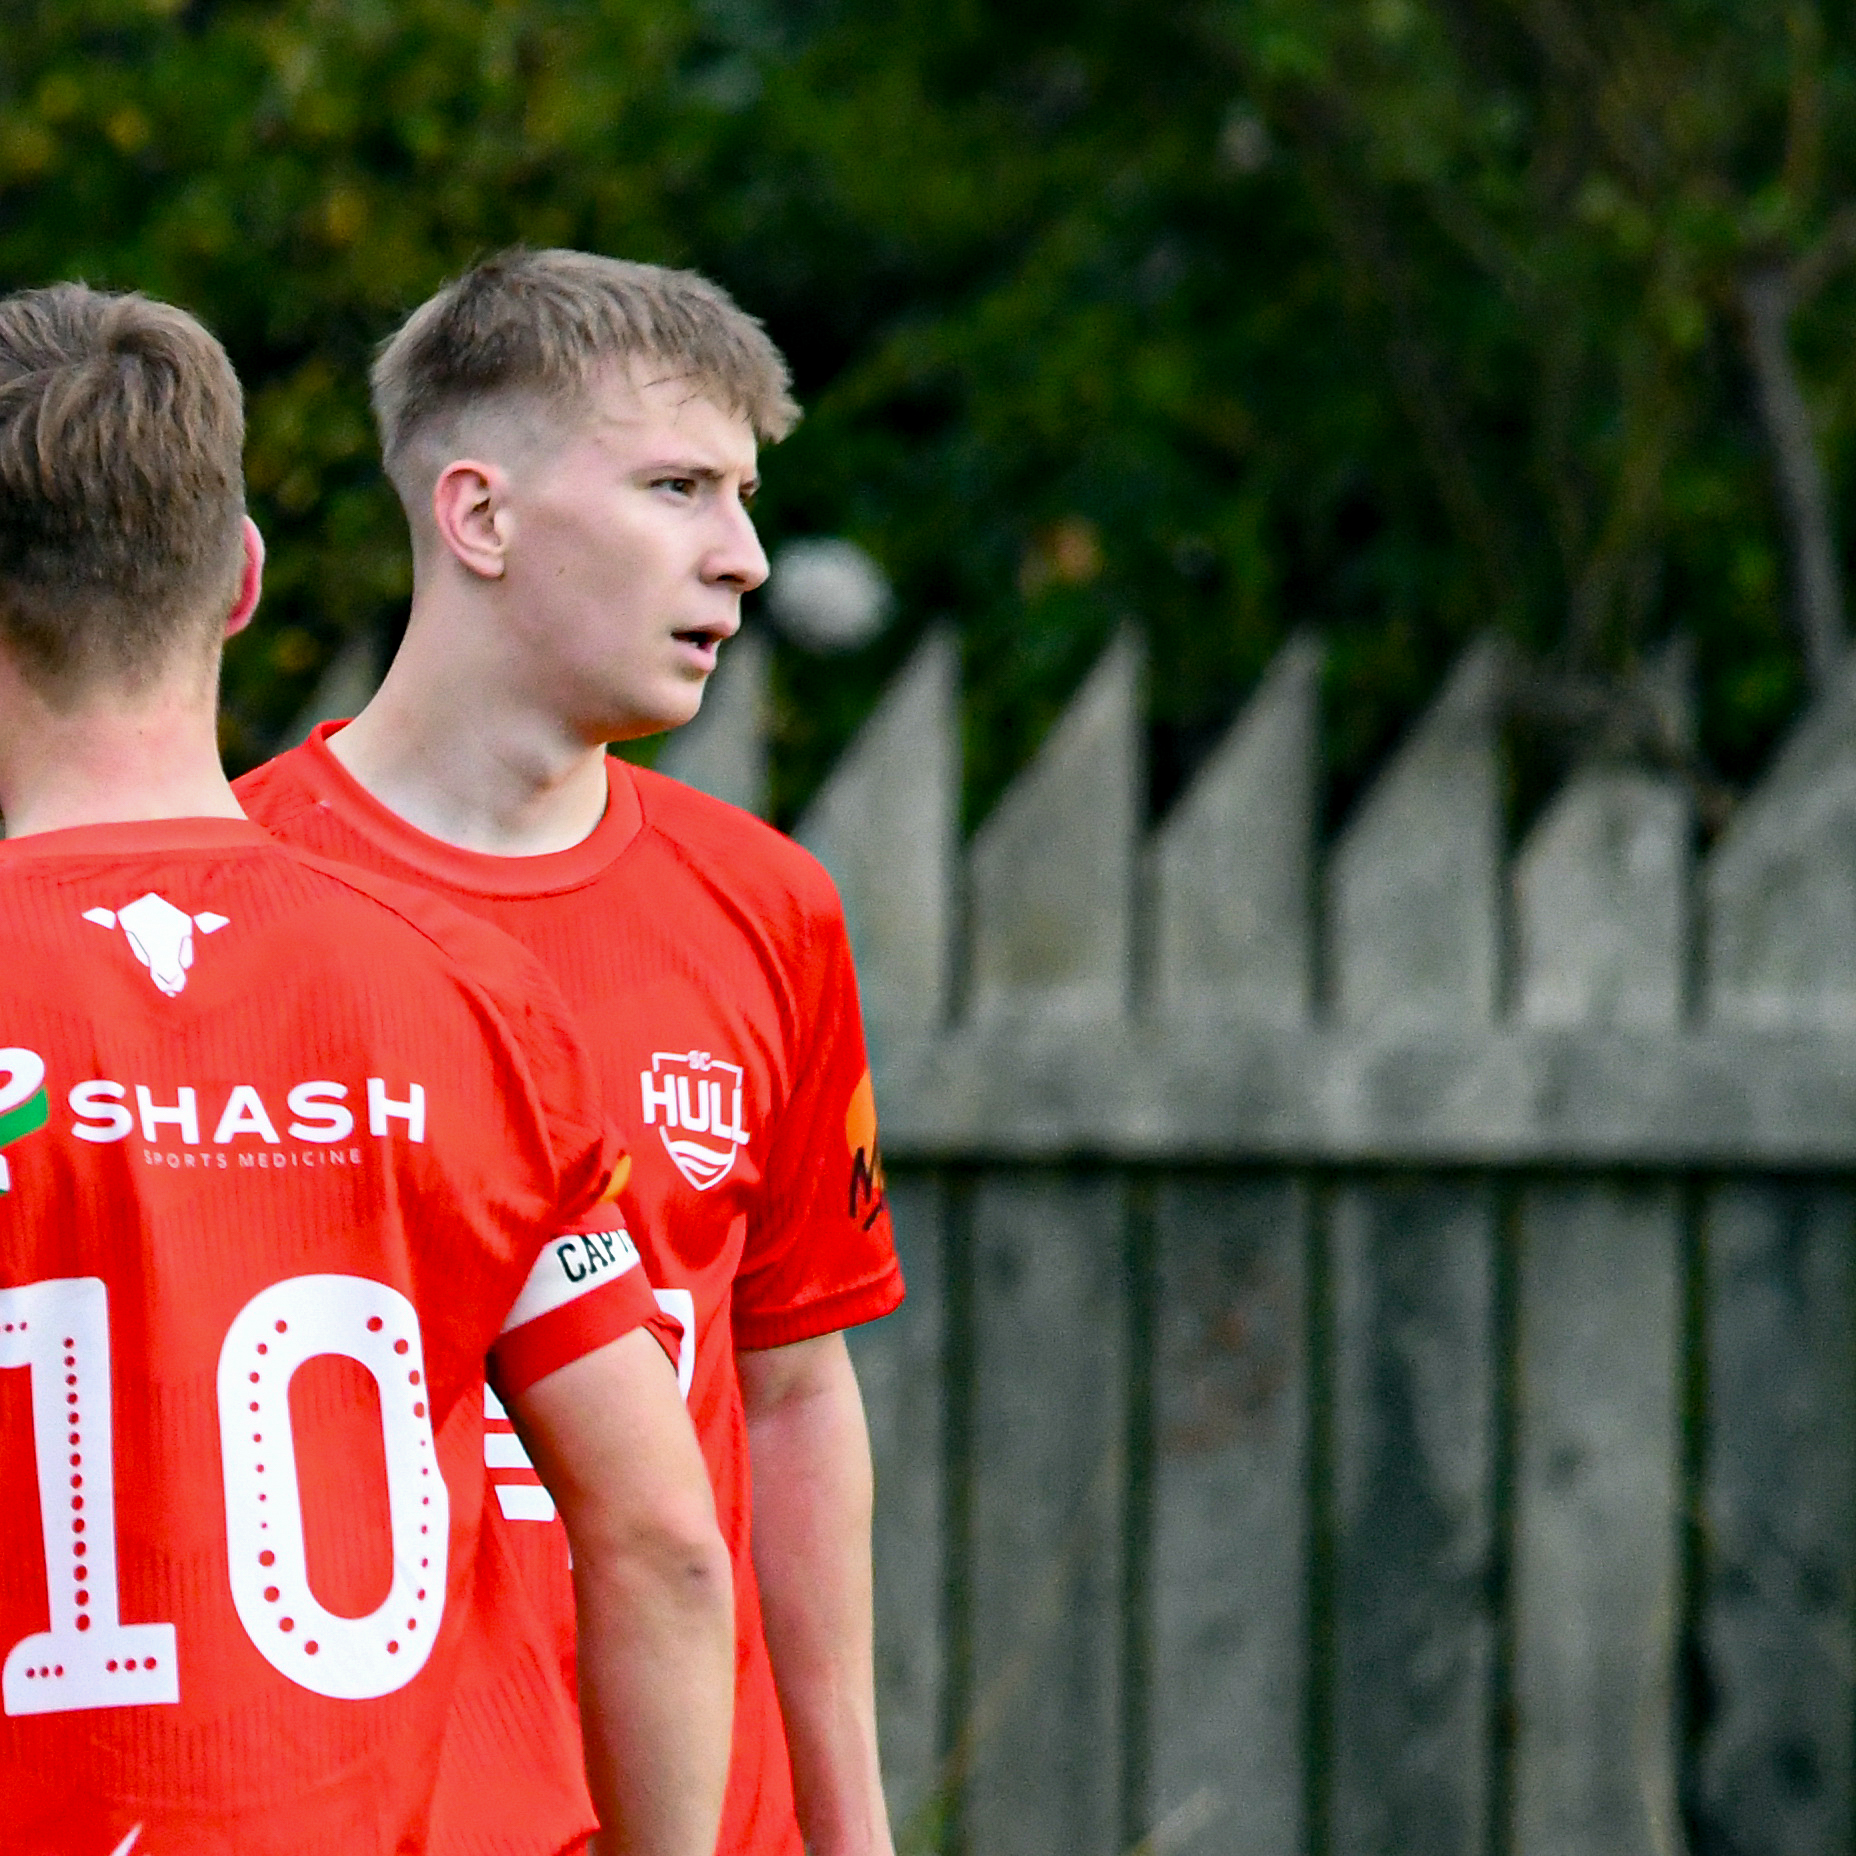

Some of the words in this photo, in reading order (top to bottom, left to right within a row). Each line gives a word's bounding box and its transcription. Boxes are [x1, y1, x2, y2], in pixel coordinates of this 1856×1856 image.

[68, 1077, 426, 1144] SHASH
[640, 1070, 751, 1145] HULL
[143, 1149, 228, 1170] SPORTS
[238, 1147, 363, 1169] MEDICINE
